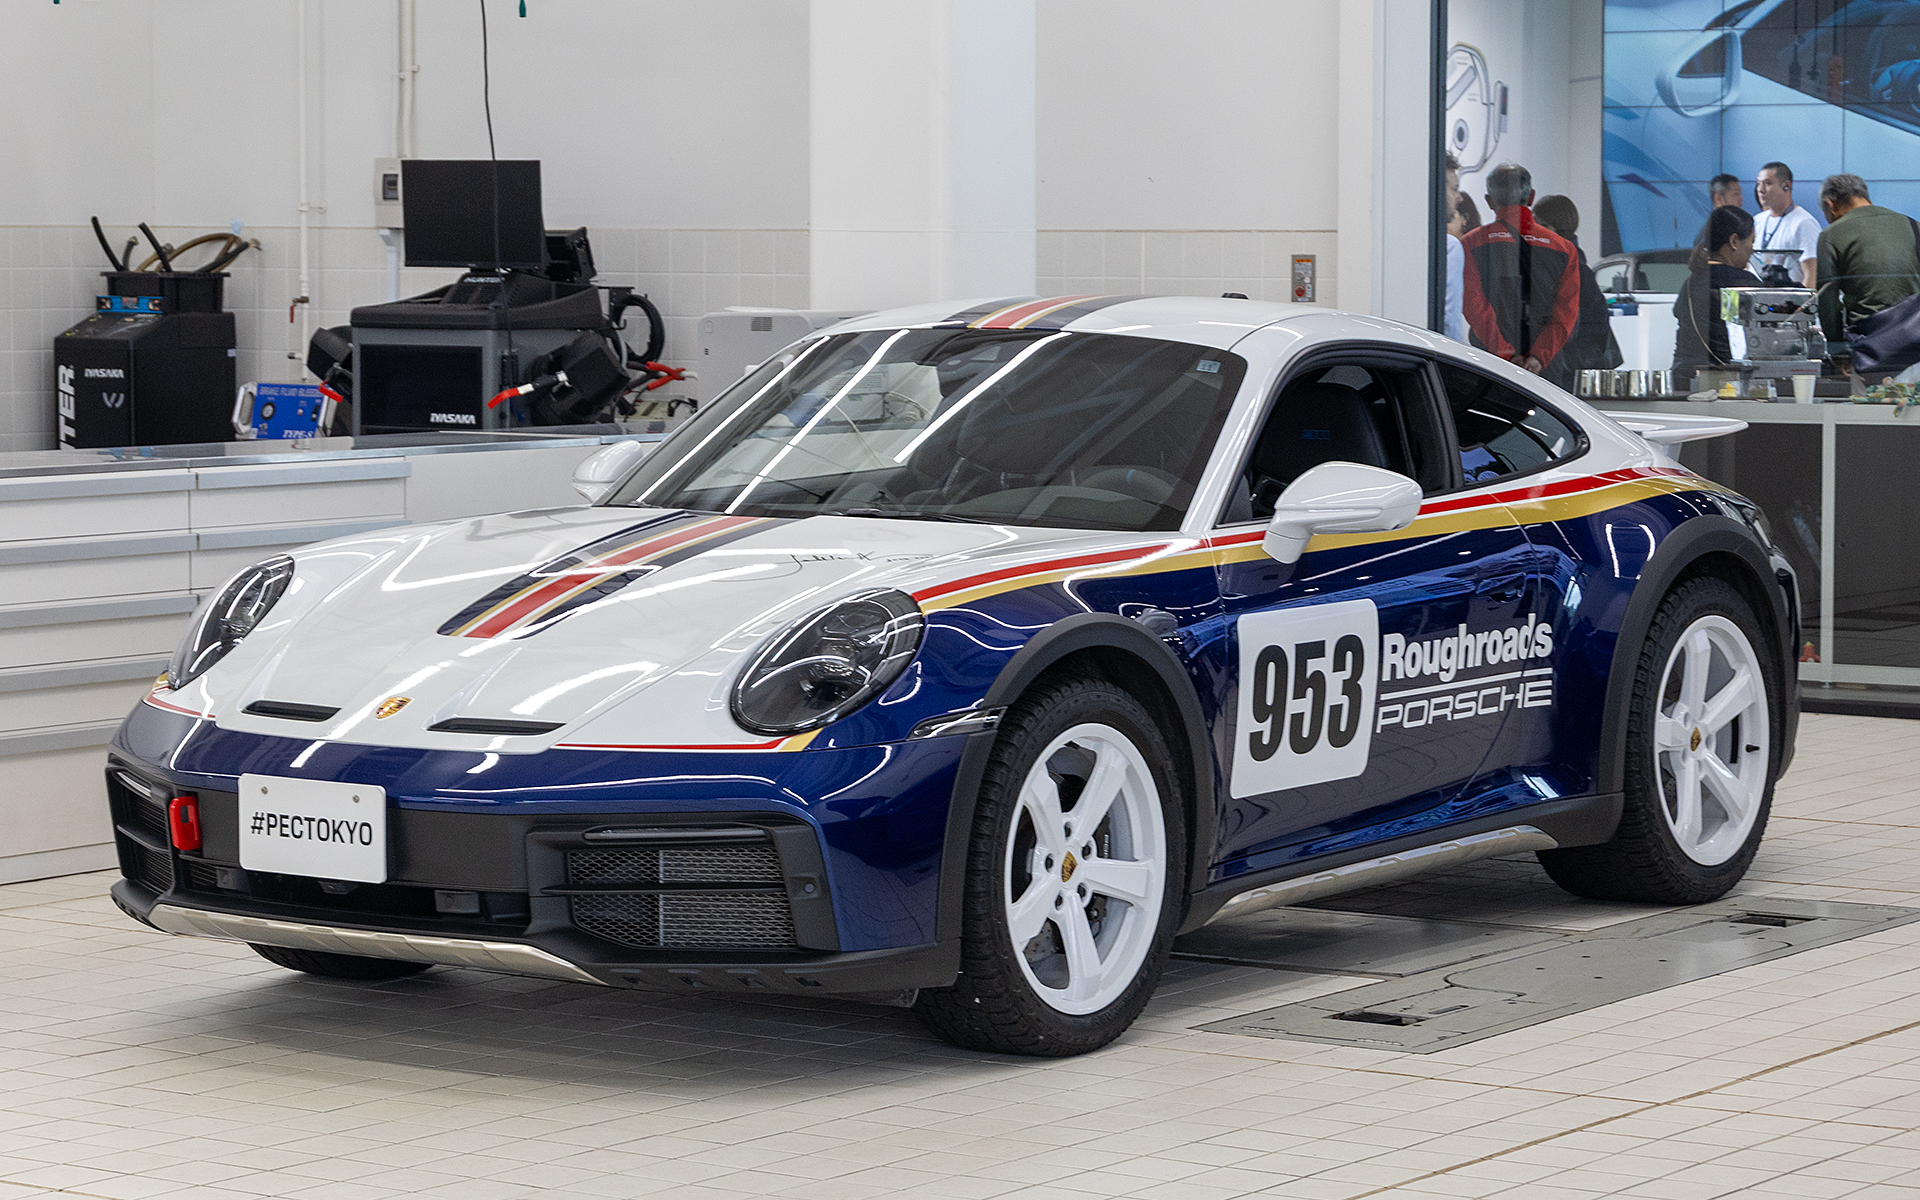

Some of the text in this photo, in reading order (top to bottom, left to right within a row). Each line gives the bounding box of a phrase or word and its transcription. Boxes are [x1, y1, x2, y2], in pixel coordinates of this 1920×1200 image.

[58, 364, 76, 450] TER
[430, 412, 476, 425] IYASAKA
[1381, 613, 1554, 682] Roughroads
[1249, 633, 1365, 762] 953
[1375, 679, 1553, 734] PORSCHE
[250, 811, 373, 846] #PECTOKYO
